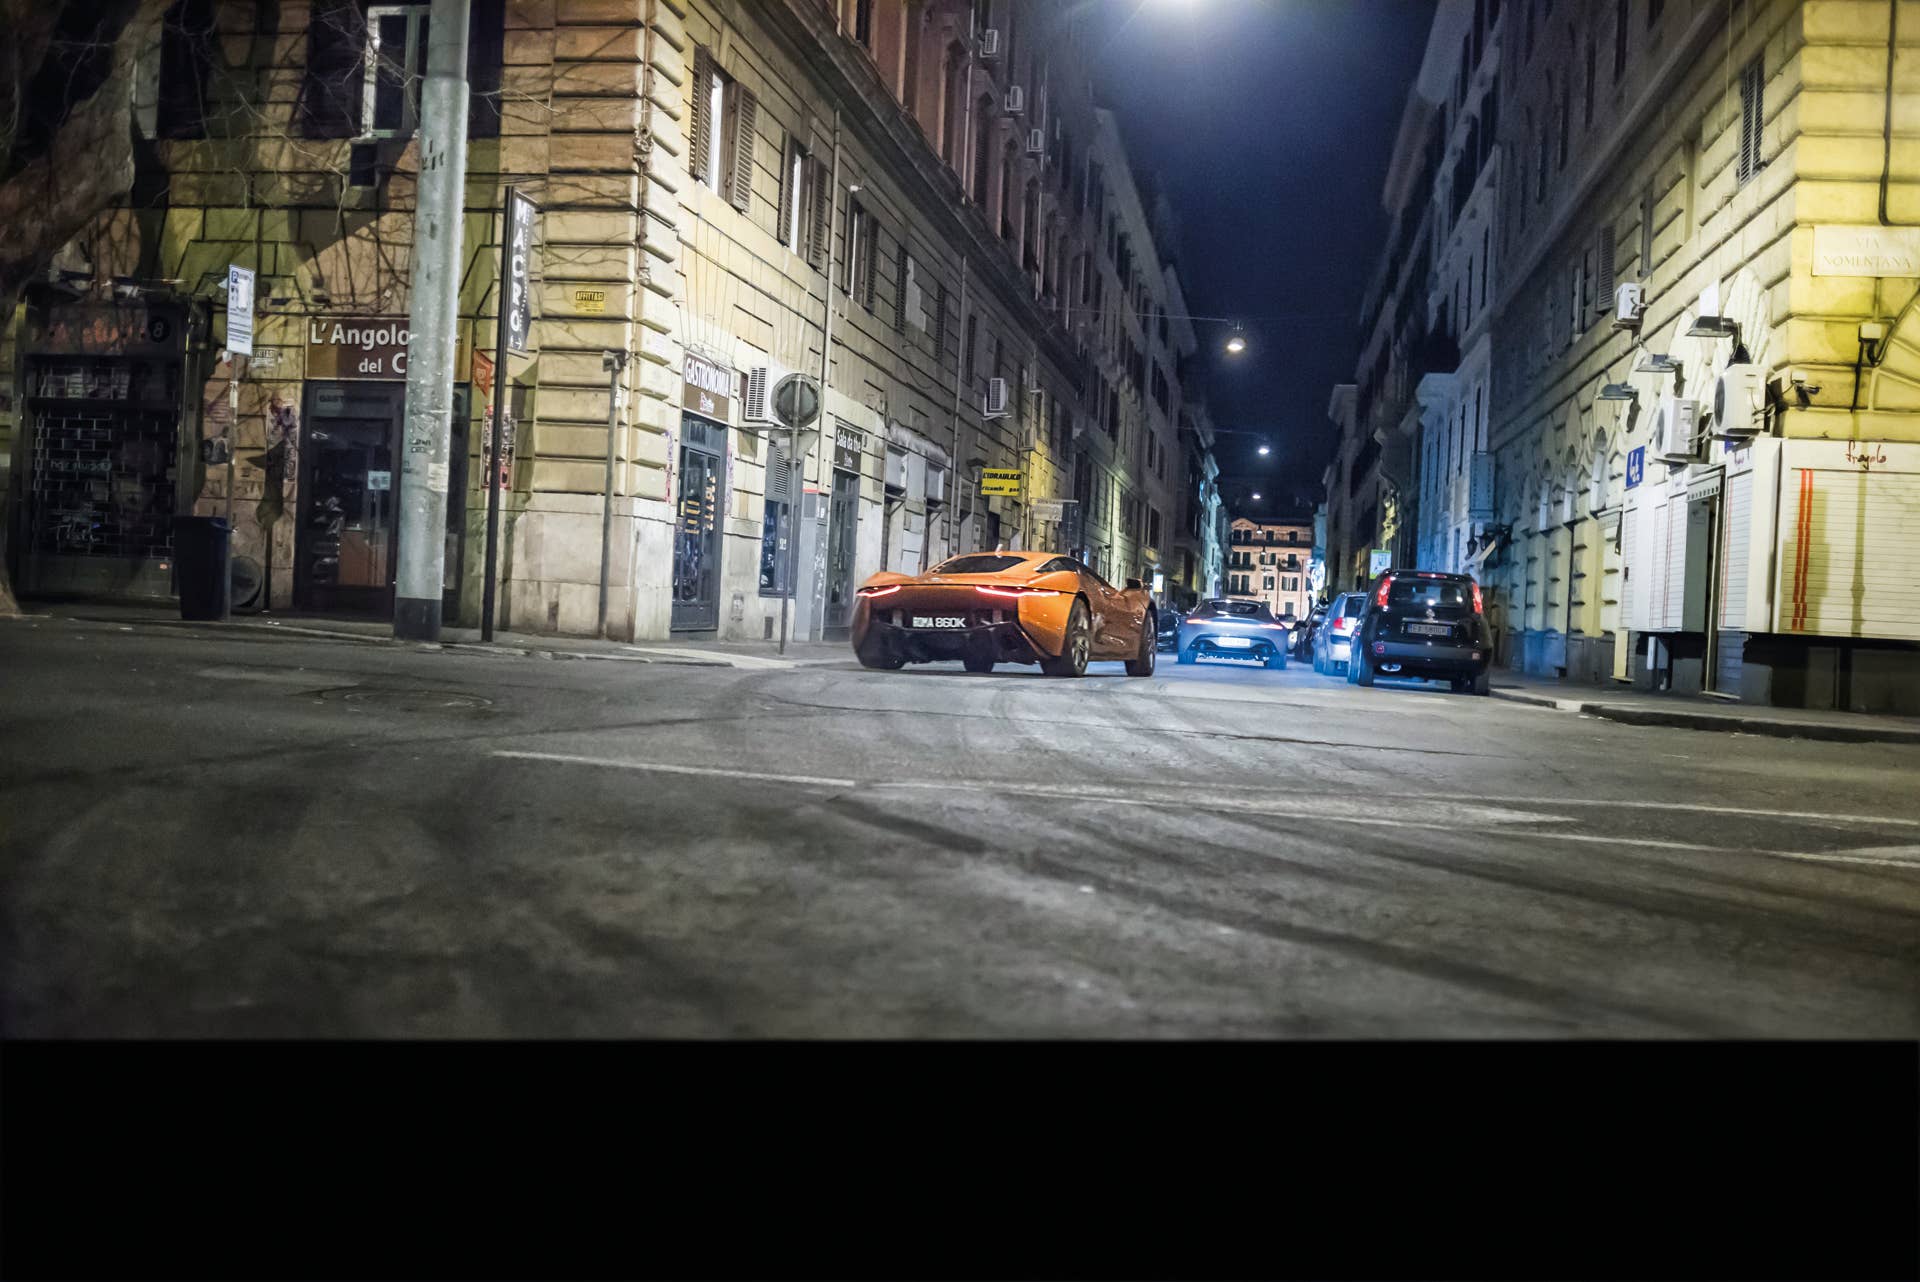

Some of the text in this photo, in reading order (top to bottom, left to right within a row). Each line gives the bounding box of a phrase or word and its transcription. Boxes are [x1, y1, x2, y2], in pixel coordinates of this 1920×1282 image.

[1855, 236, 1880, 249] VIA
[509, 197, 528, 333] MACRO
[1823, 255, 1911, 269] NOMENTANA
[358, 351, 407, 374] del C
[685, 357, 730, 399] GASTRONOMIA
[935, 617, 966, 628] 860K
